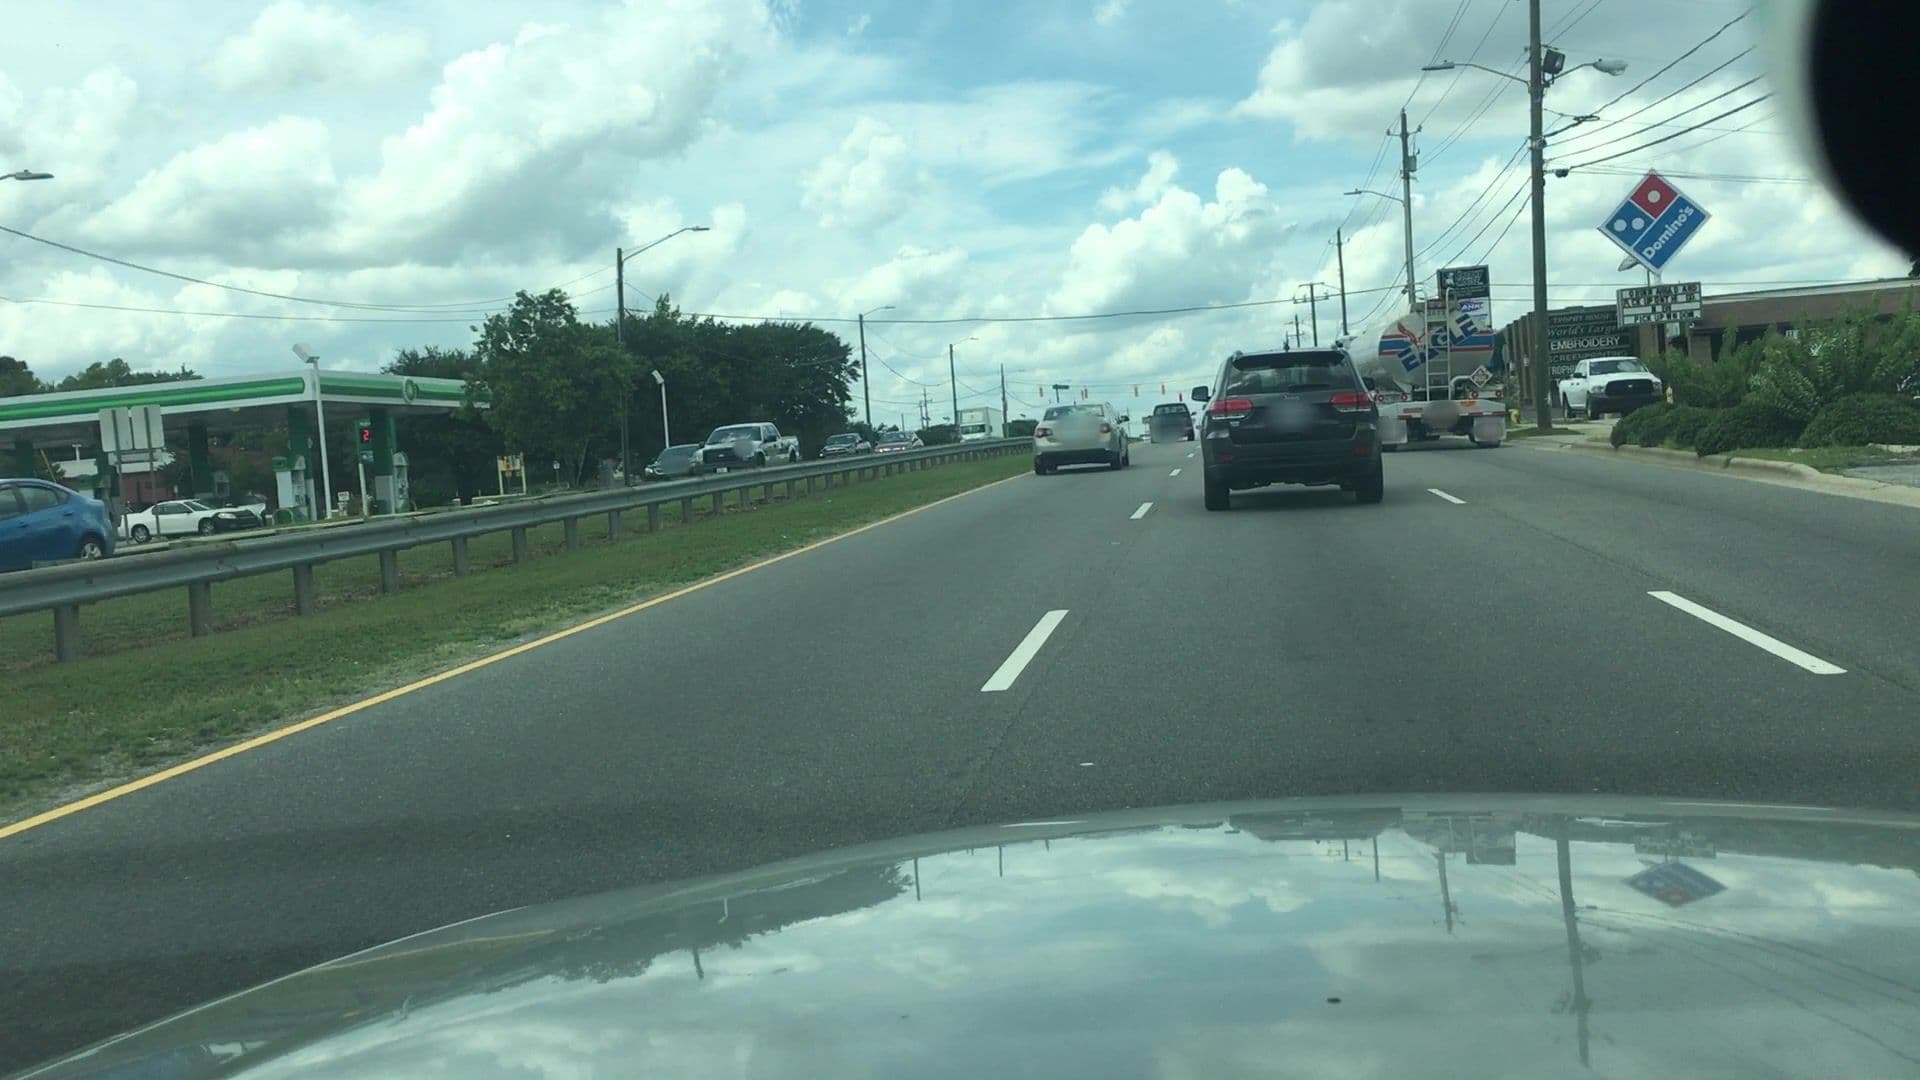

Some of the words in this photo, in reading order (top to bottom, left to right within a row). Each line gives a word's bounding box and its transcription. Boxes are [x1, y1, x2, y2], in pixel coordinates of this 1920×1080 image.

[1641, 205, 1695, 260] Domino's
[1397, 313, 1478, 372] EAGLE
[1550, 336, 1620, 350] EMBROIDERY
